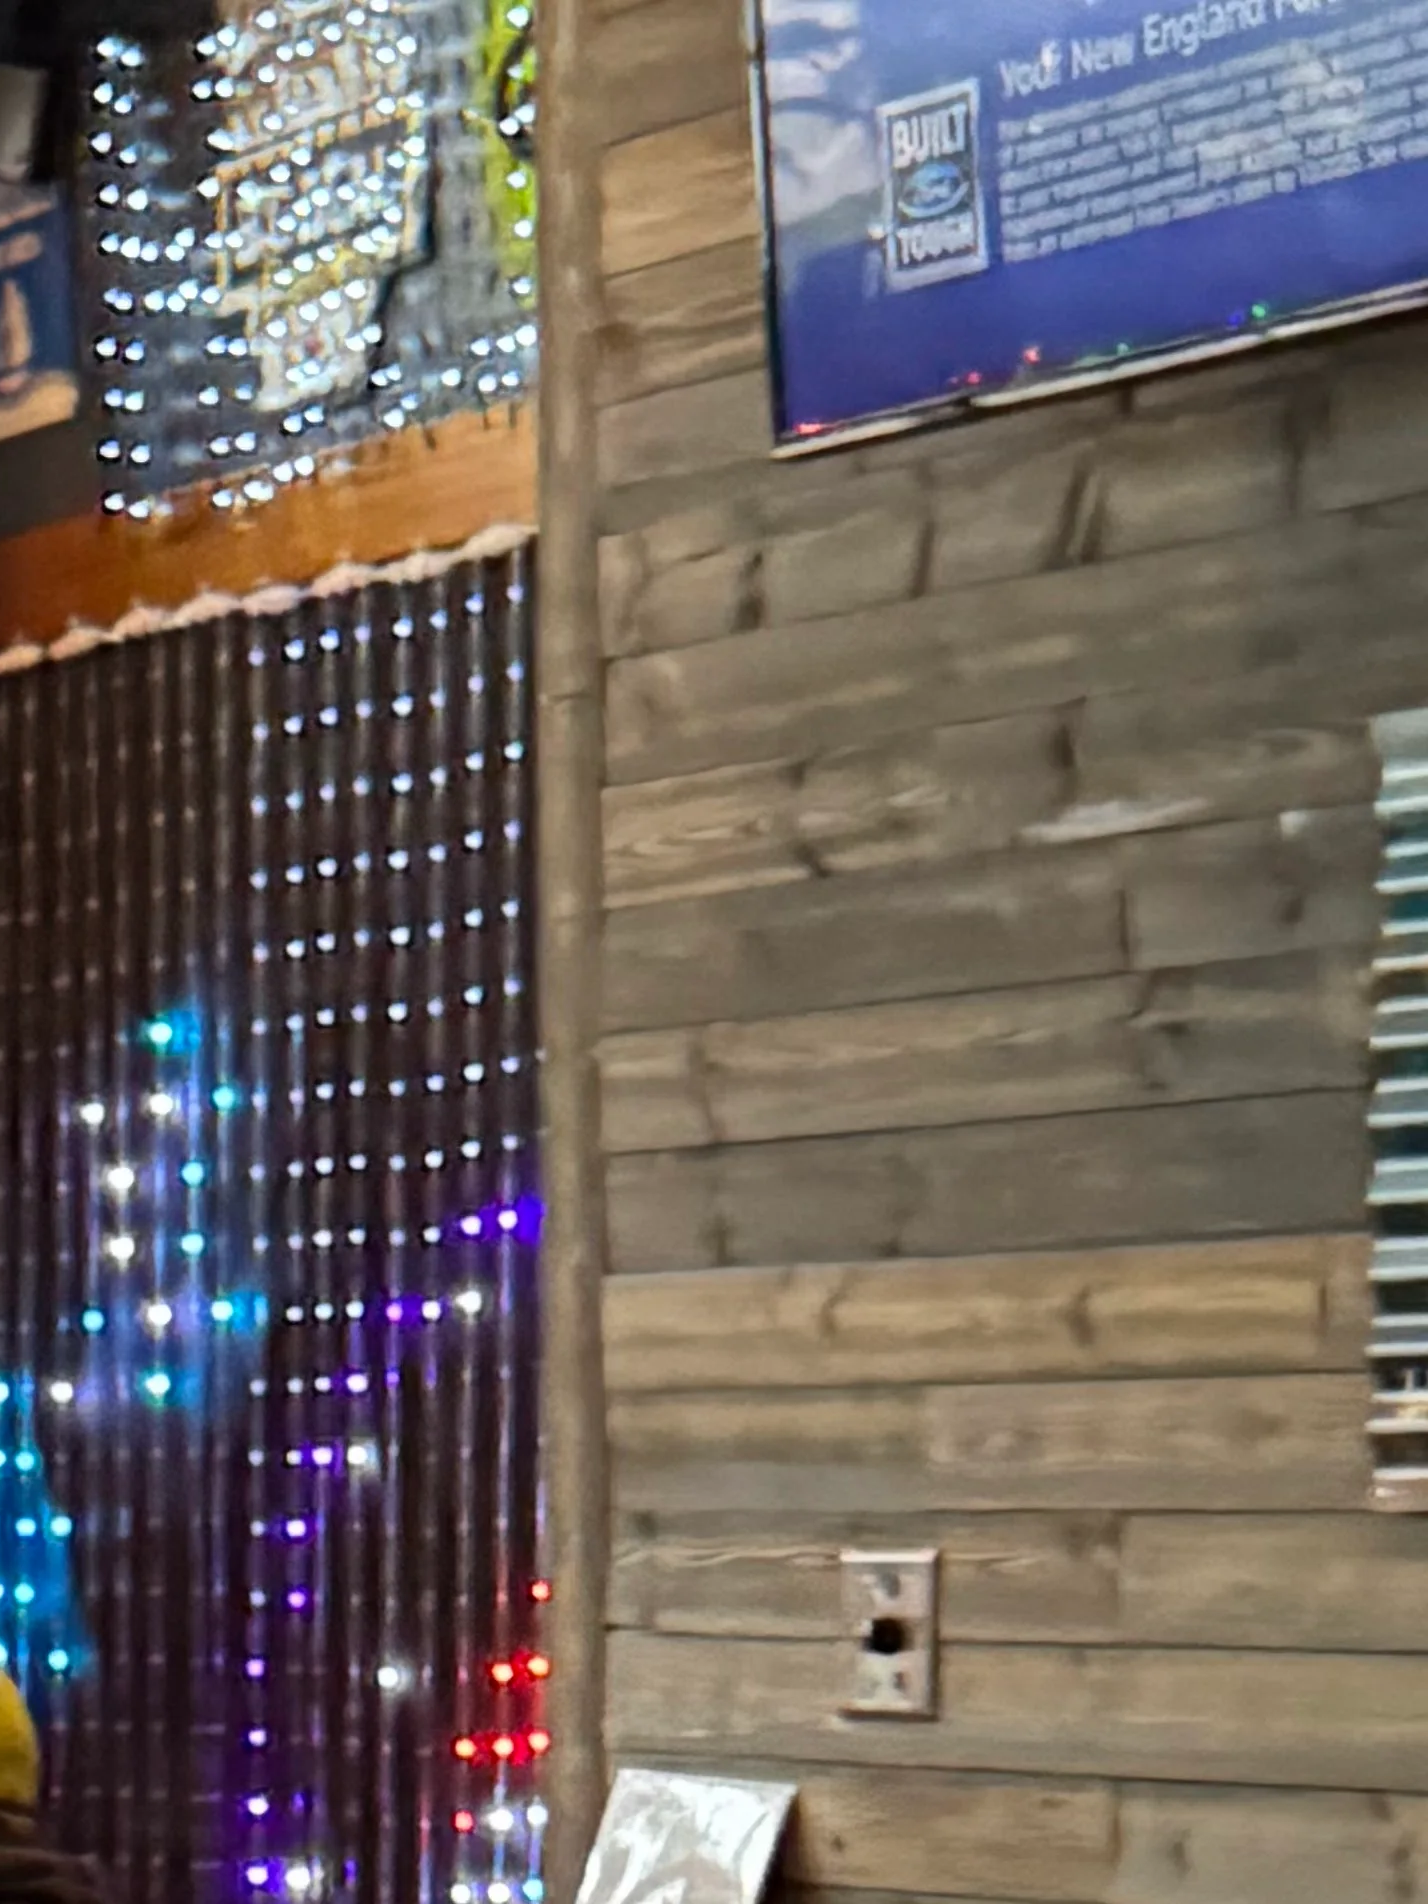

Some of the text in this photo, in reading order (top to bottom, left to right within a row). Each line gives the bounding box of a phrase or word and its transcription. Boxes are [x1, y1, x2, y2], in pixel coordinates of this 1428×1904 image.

[1070, 32, 1134, 80] New
[1144, 0, 1267, 56] England
[893, 103, 967, 168] BUILT
